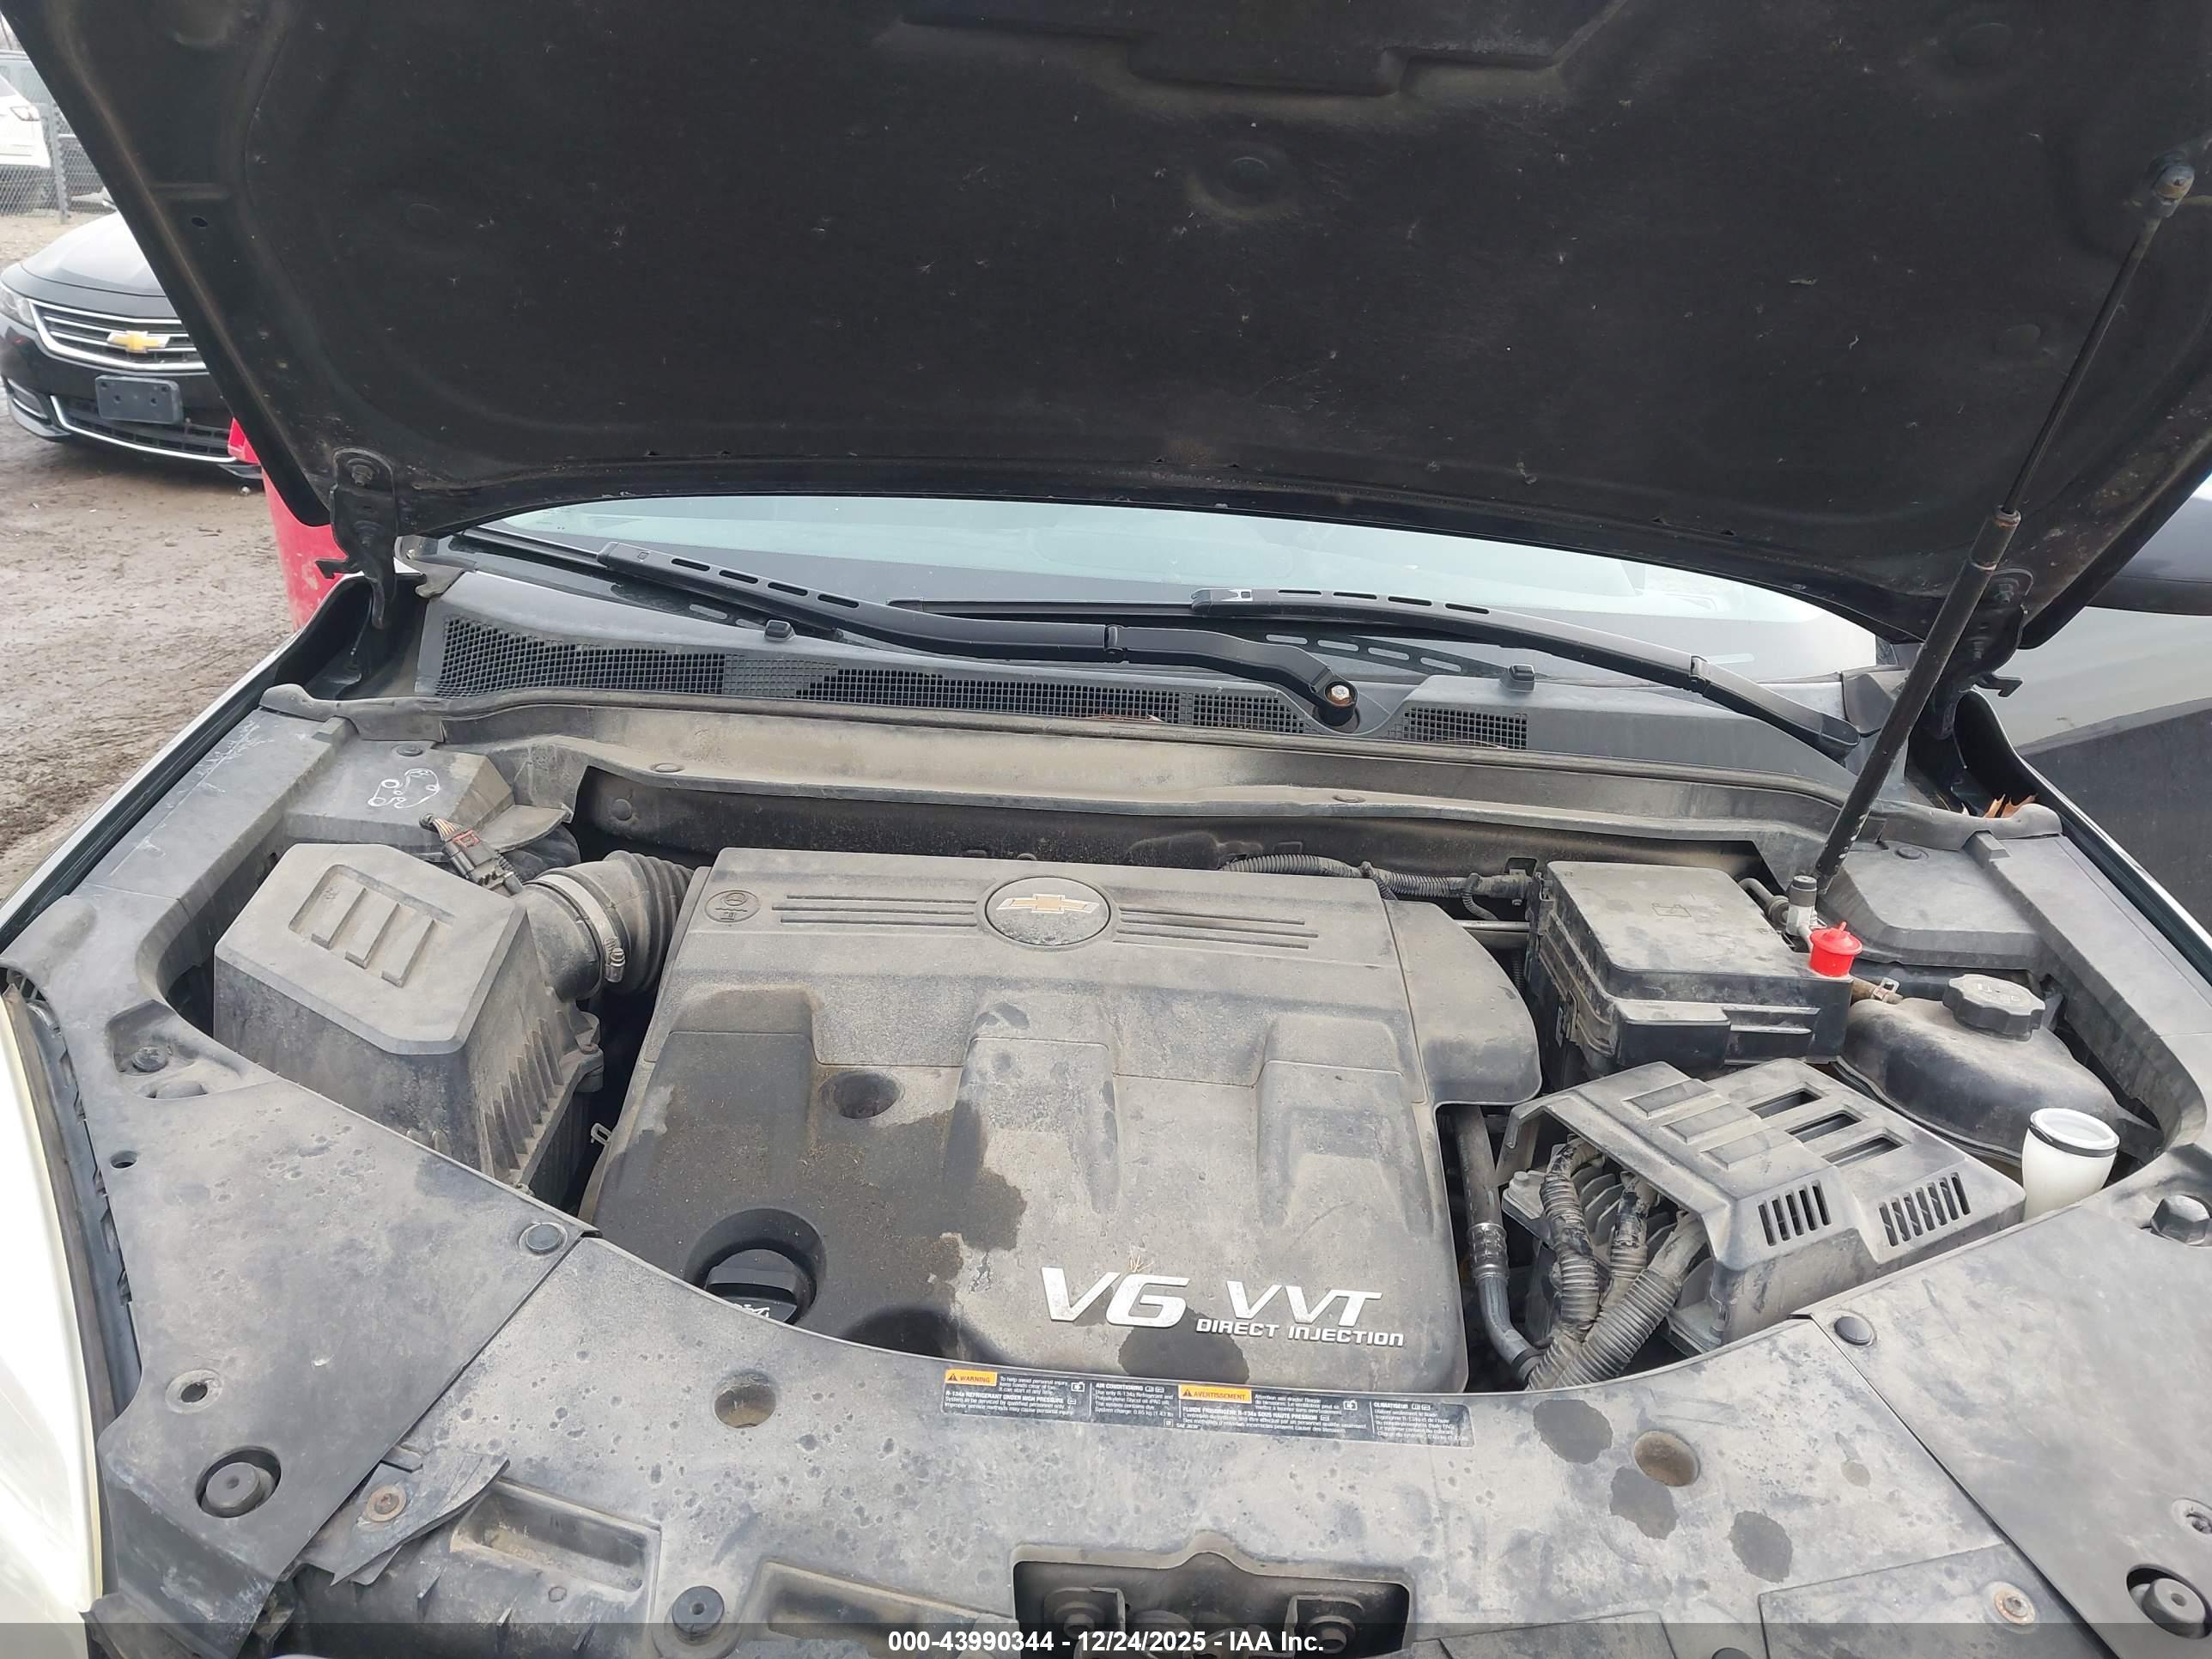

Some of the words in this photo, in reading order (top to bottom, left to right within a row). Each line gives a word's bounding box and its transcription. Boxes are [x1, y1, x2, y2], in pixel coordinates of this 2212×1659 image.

[1041, 1267, 1190, 1328] V6
[1226, 1280, 1382, 1327] VVT
[1196, 1318, 1280, 1342] DIRECT
[1287, 1324, 1405, 1347] INJECTION
[960, 1375, 990, 1383] WARNING
[965, 1391, 1002, 1400] REFRIGERANT
[1194, 1391, 1246, 1400] AVERTISSEMENT
